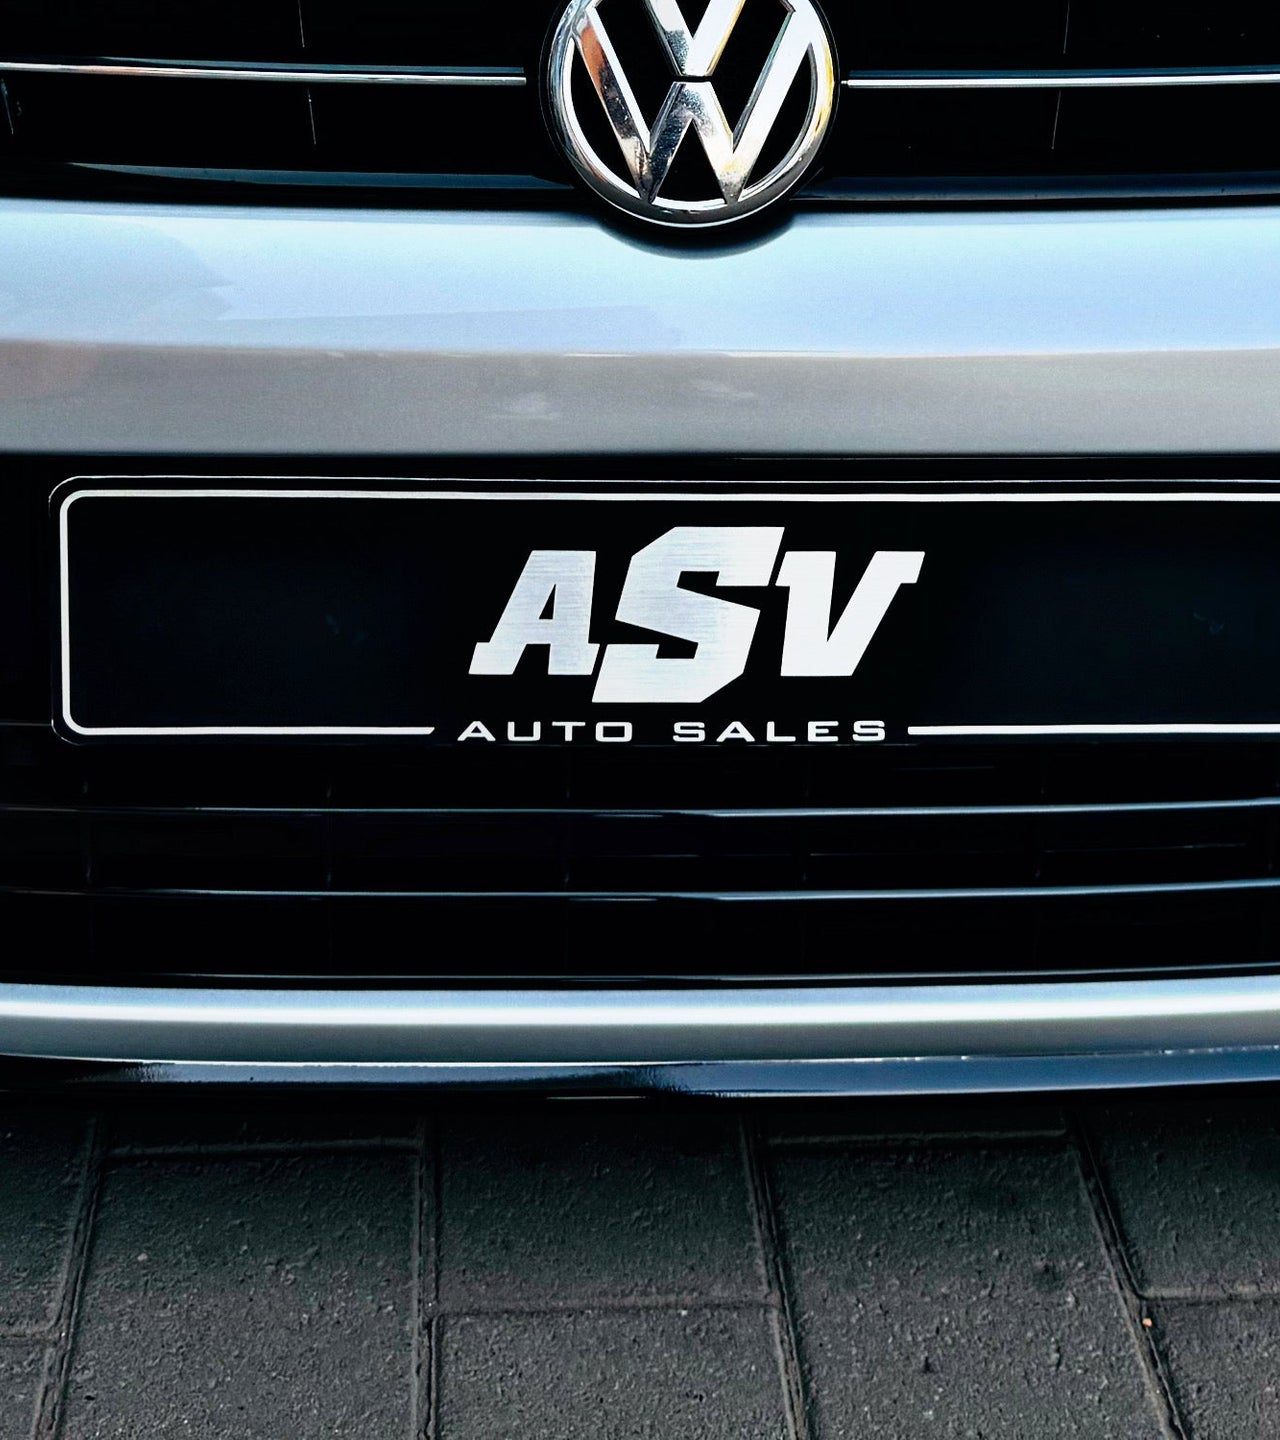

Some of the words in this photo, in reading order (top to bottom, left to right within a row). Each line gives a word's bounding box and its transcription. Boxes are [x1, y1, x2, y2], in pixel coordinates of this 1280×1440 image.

[468, 526, 926, 704] ASV
[457, 720, 633, 743] AUTO
[672, 720, 886, 743] SALES
